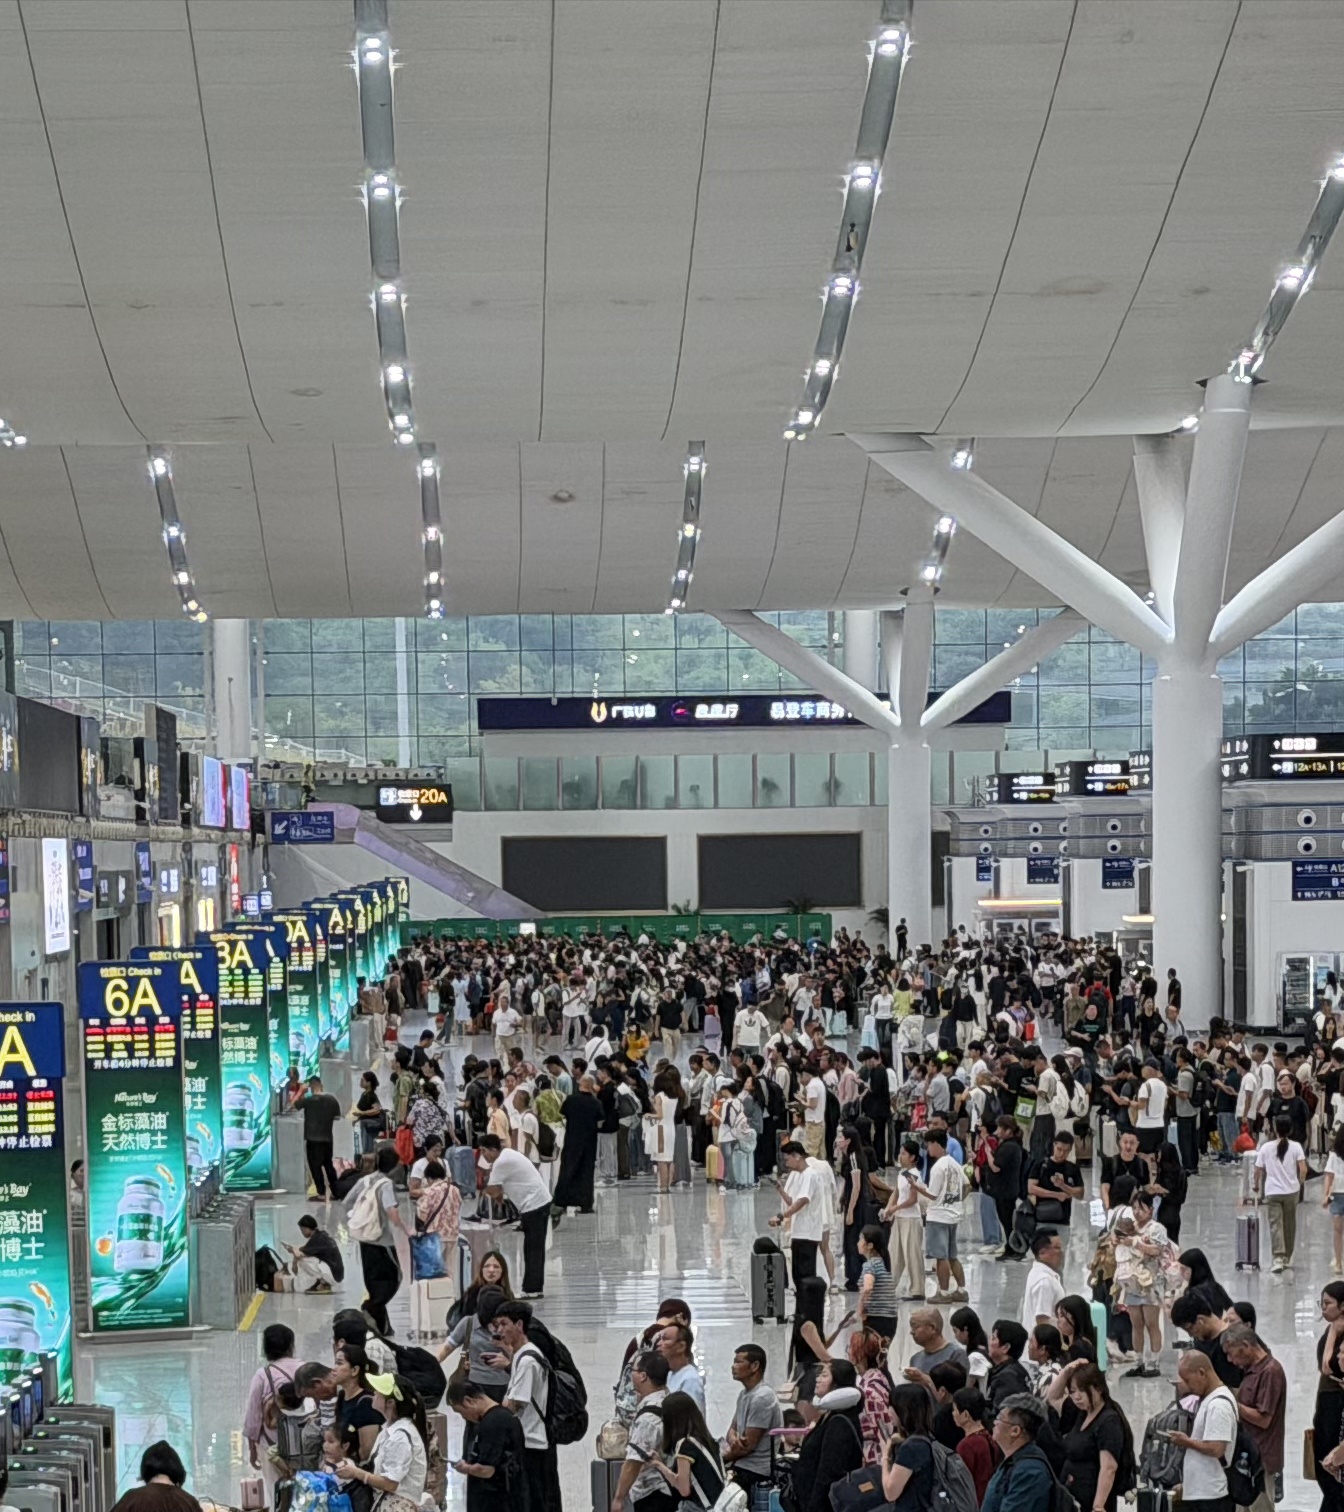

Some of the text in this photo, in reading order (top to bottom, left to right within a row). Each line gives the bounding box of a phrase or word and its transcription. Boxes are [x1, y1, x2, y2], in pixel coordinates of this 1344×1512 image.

[1294, 763, 1327, 771] 12A-13A
[420, 788, 447, 803] 20A
[128, 967, 153, 977] Check
[105, 978, 162, 1016] 6A
[25, 1011, 35, 1023] in
[102, 1132, 168, 1152] 天然博士
